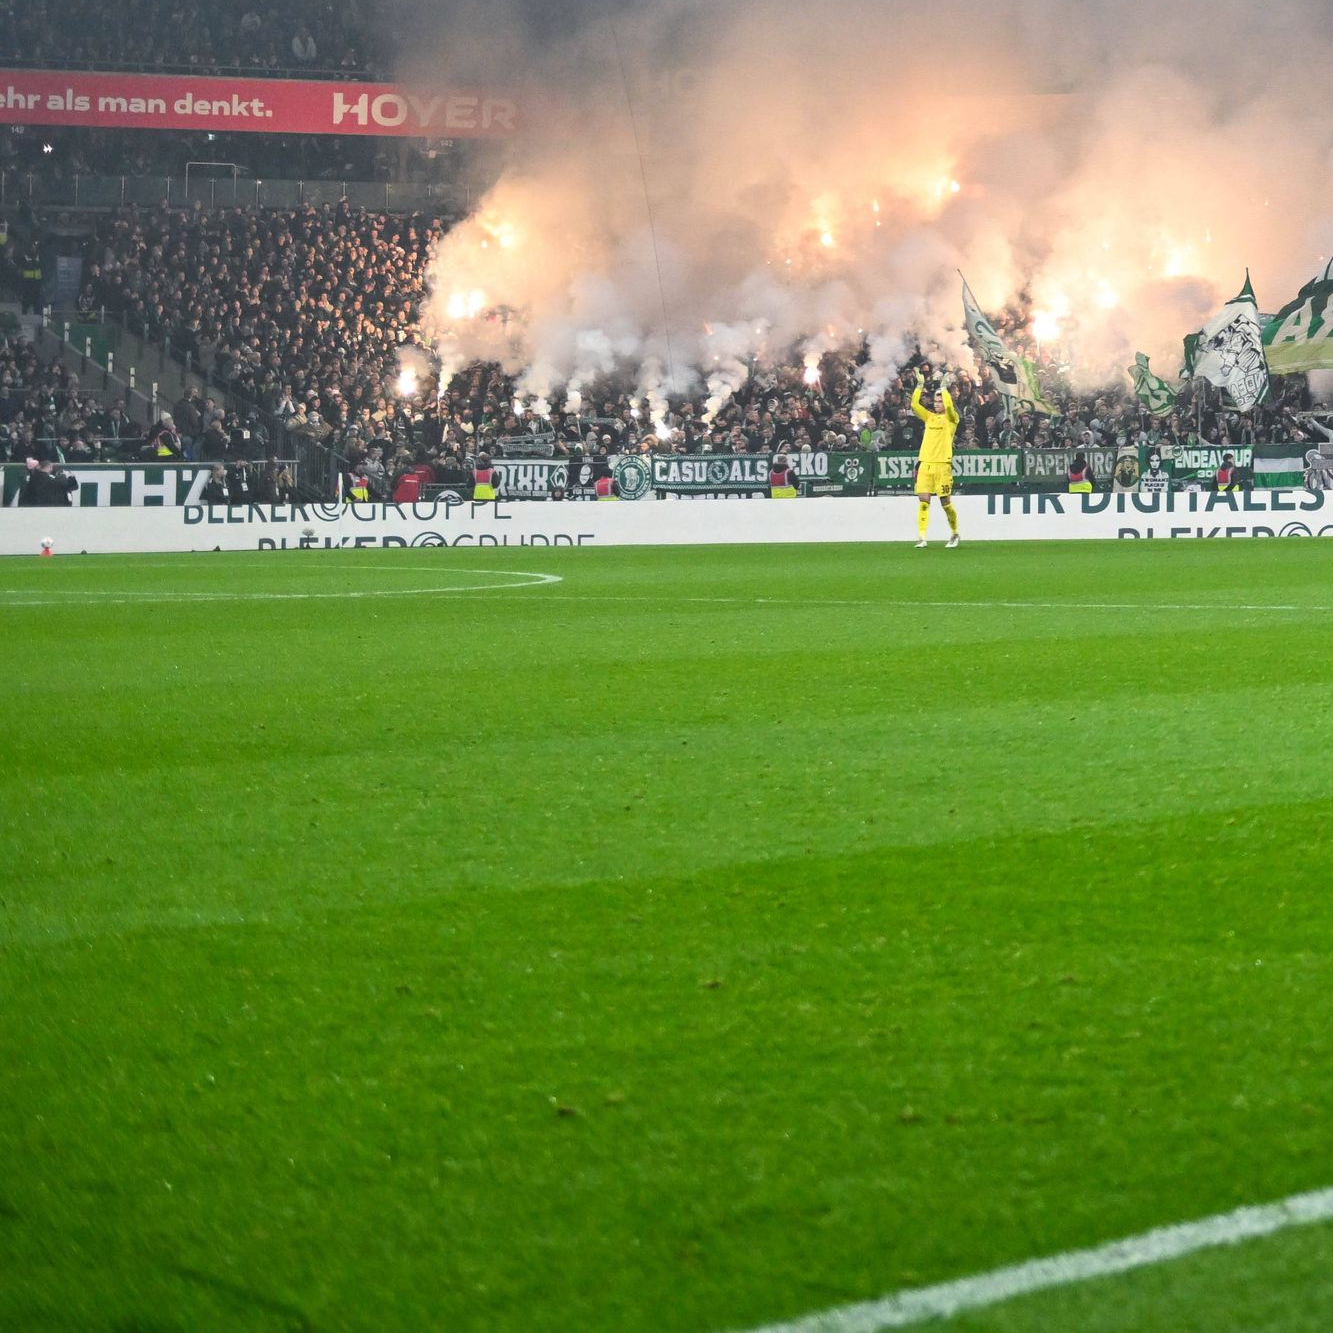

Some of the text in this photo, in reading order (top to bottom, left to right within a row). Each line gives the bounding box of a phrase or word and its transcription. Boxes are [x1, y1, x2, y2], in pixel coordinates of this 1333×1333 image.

[0, 86, 273, 118] hr als man denkt.
[333, 92, 518, 130] HOYER
[1025, 450, 1115, 477] PAPENURG
[941, 484, 950, 495] 30
